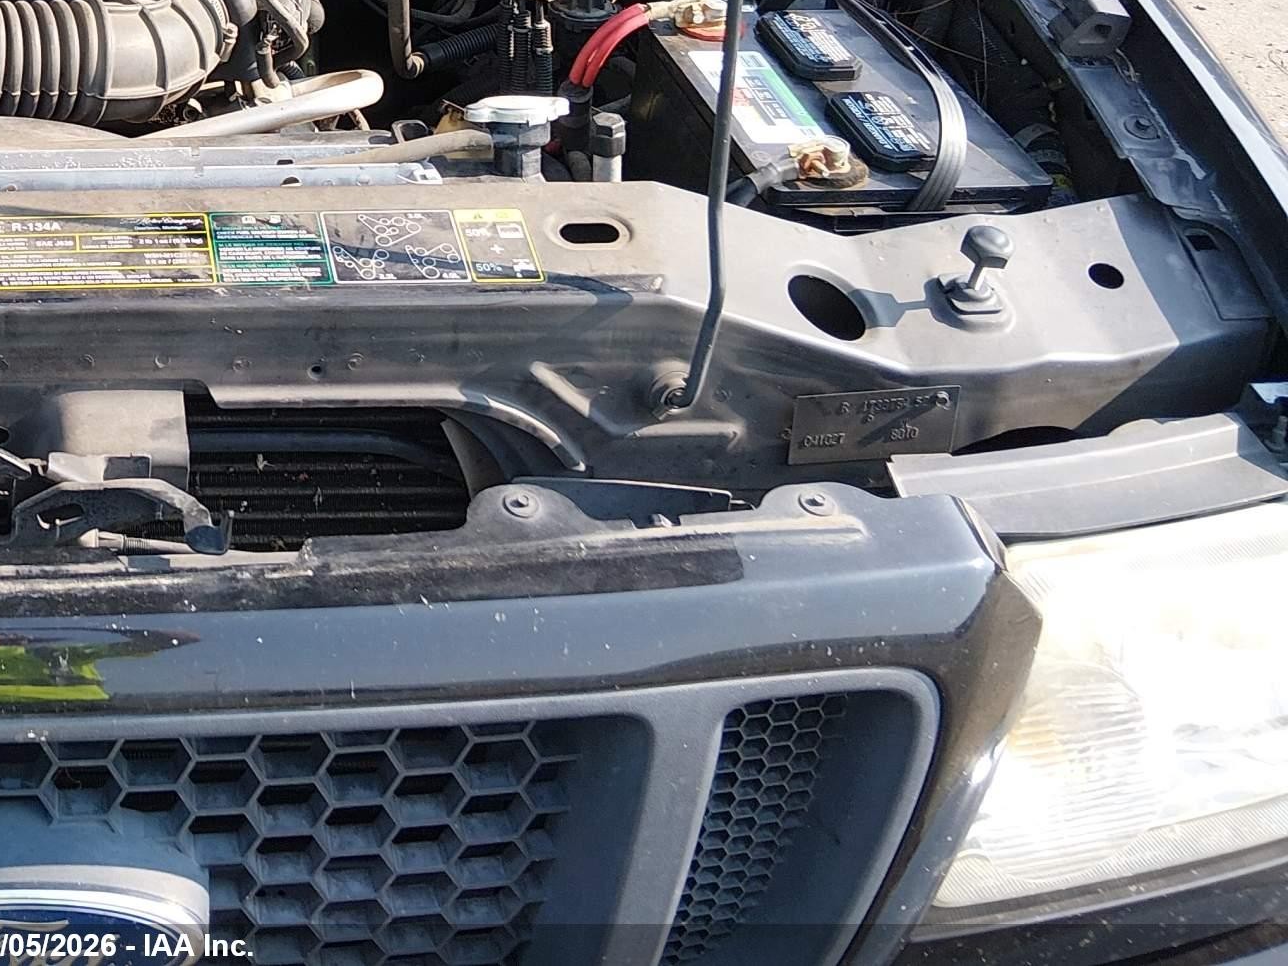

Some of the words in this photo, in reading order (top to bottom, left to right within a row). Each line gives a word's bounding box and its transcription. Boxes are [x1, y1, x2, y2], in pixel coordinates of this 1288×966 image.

[11, 221, 62, 232] R-134A
[465, 228, 491, 237] 50%
[475, 263, 503, 272] 50%
